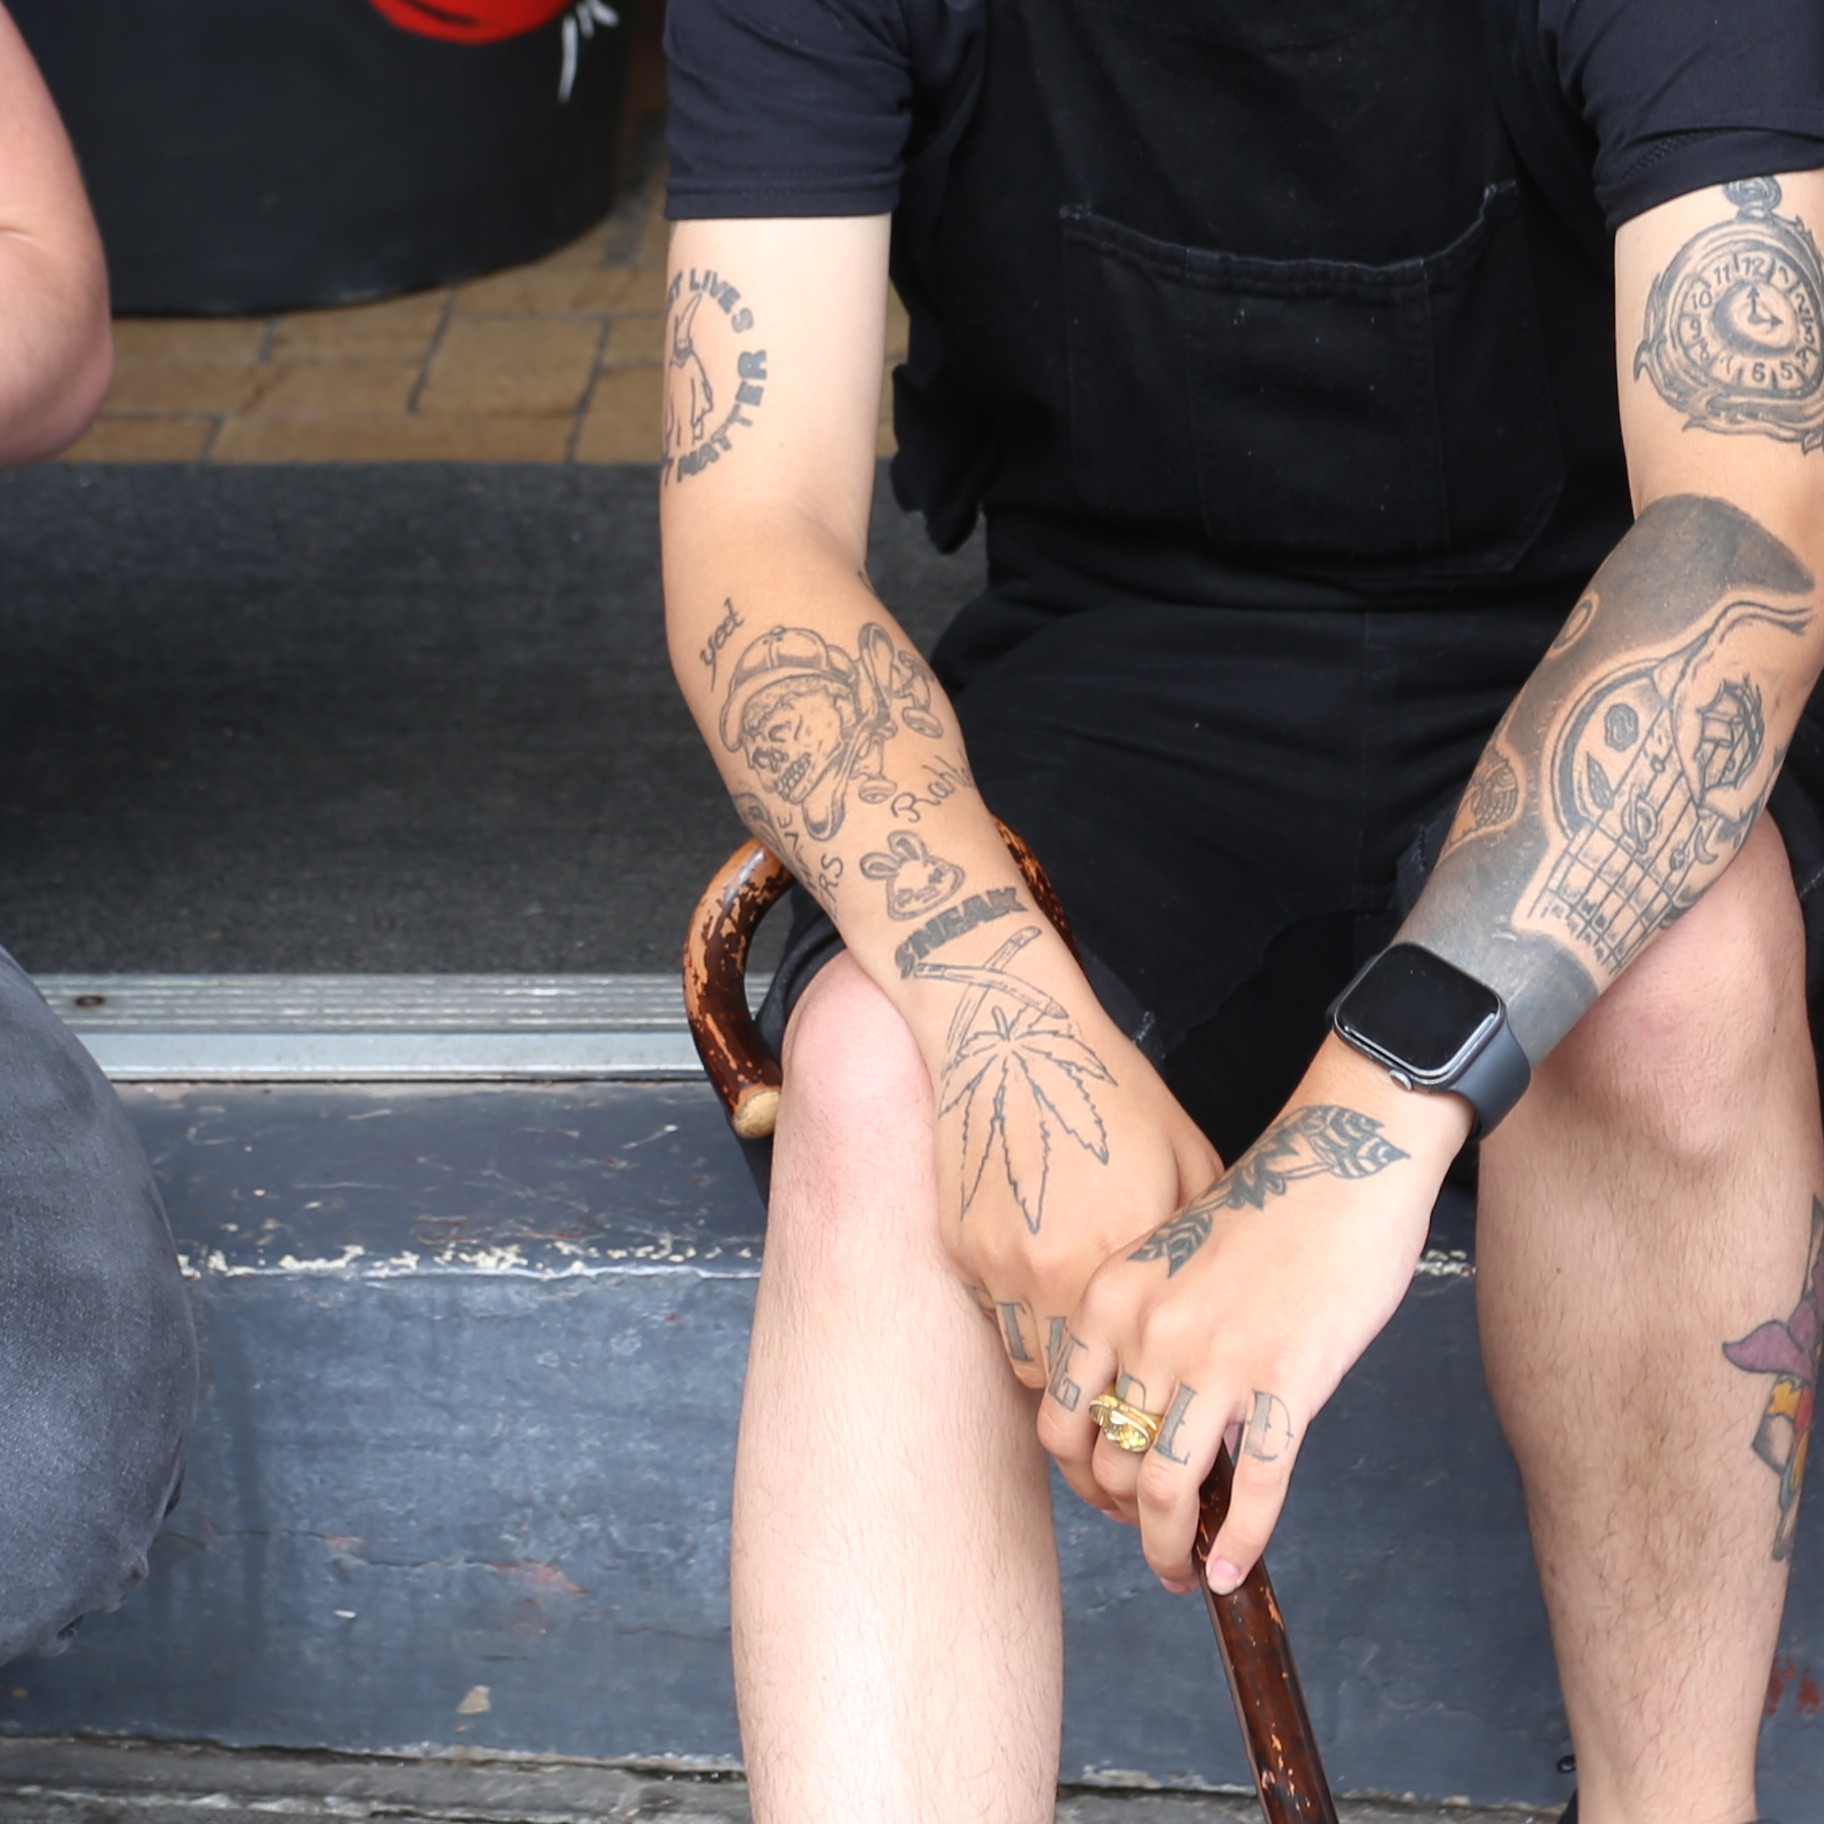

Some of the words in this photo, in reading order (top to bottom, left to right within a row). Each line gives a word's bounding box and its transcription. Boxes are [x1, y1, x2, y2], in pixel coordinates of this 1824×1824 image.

[1742, 257, 1765, 276] 12
[689, 268, 754, 333] LIVES
[1692, 290, 1712, 310] 10
[1690, 318, 1702, 339] 9
[1752, 362, 1765, 382] 6
[1780, 361, 1793, 380] 5
[677, 350, 767, 483] MATTER
